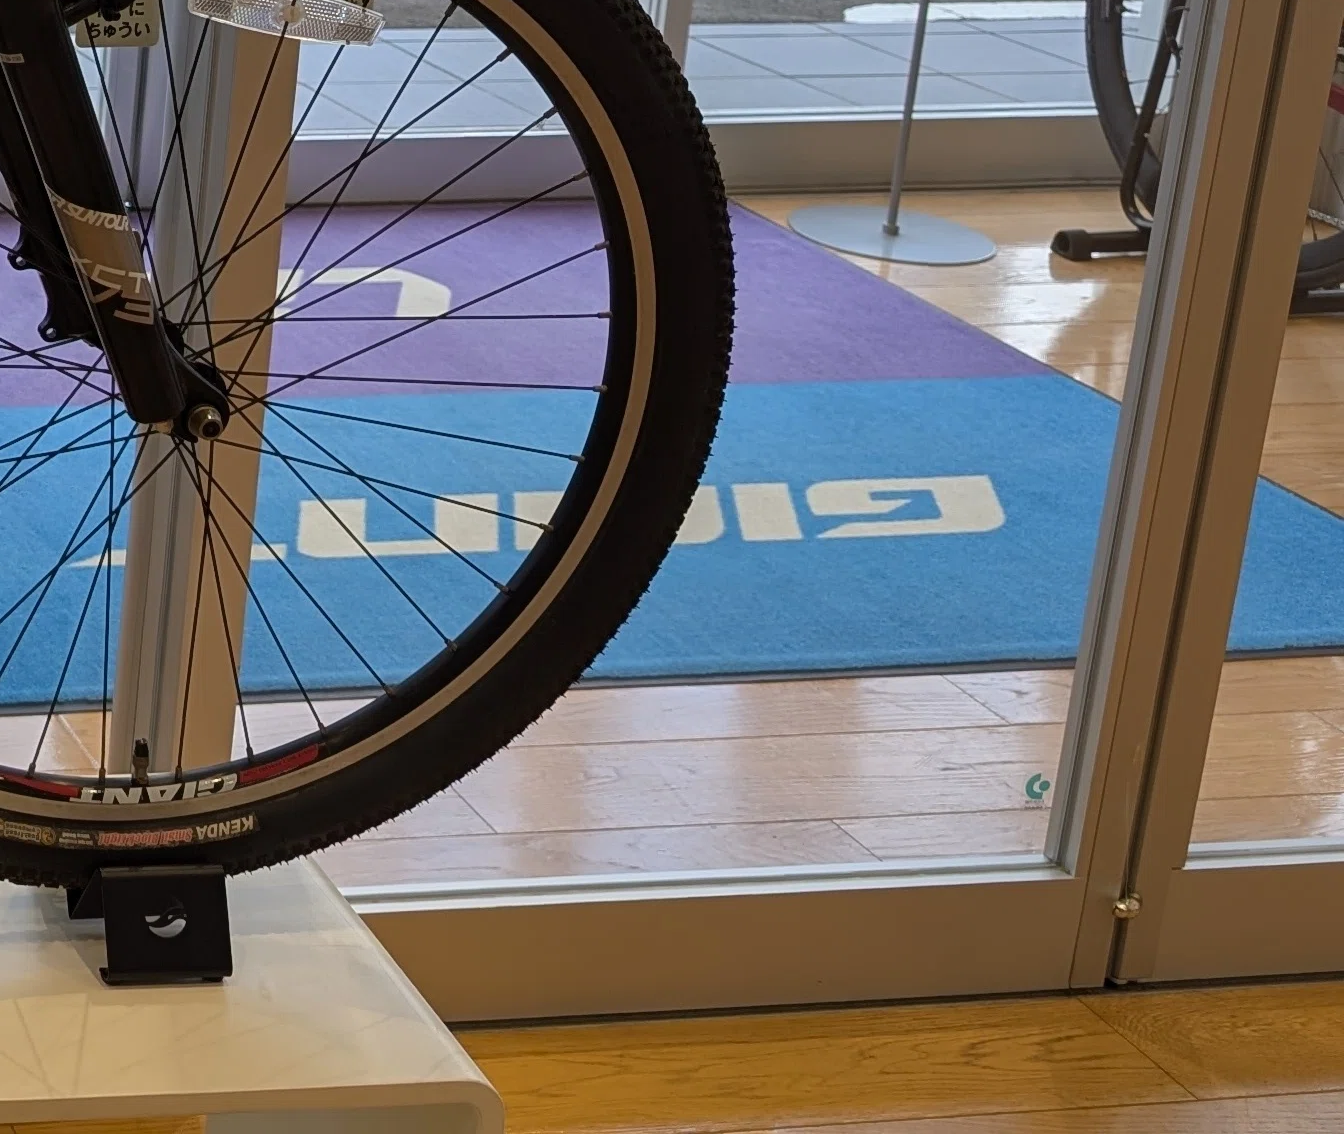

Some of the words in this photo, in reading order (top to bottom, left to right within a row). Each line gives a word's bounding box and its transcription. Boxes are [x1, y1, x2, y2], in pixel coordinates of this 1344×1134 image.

[88, 21, 151, 38] ちゅうい
[69, 772, 238, 804] GIANT
[196, 815, 254, 840] KENDA
